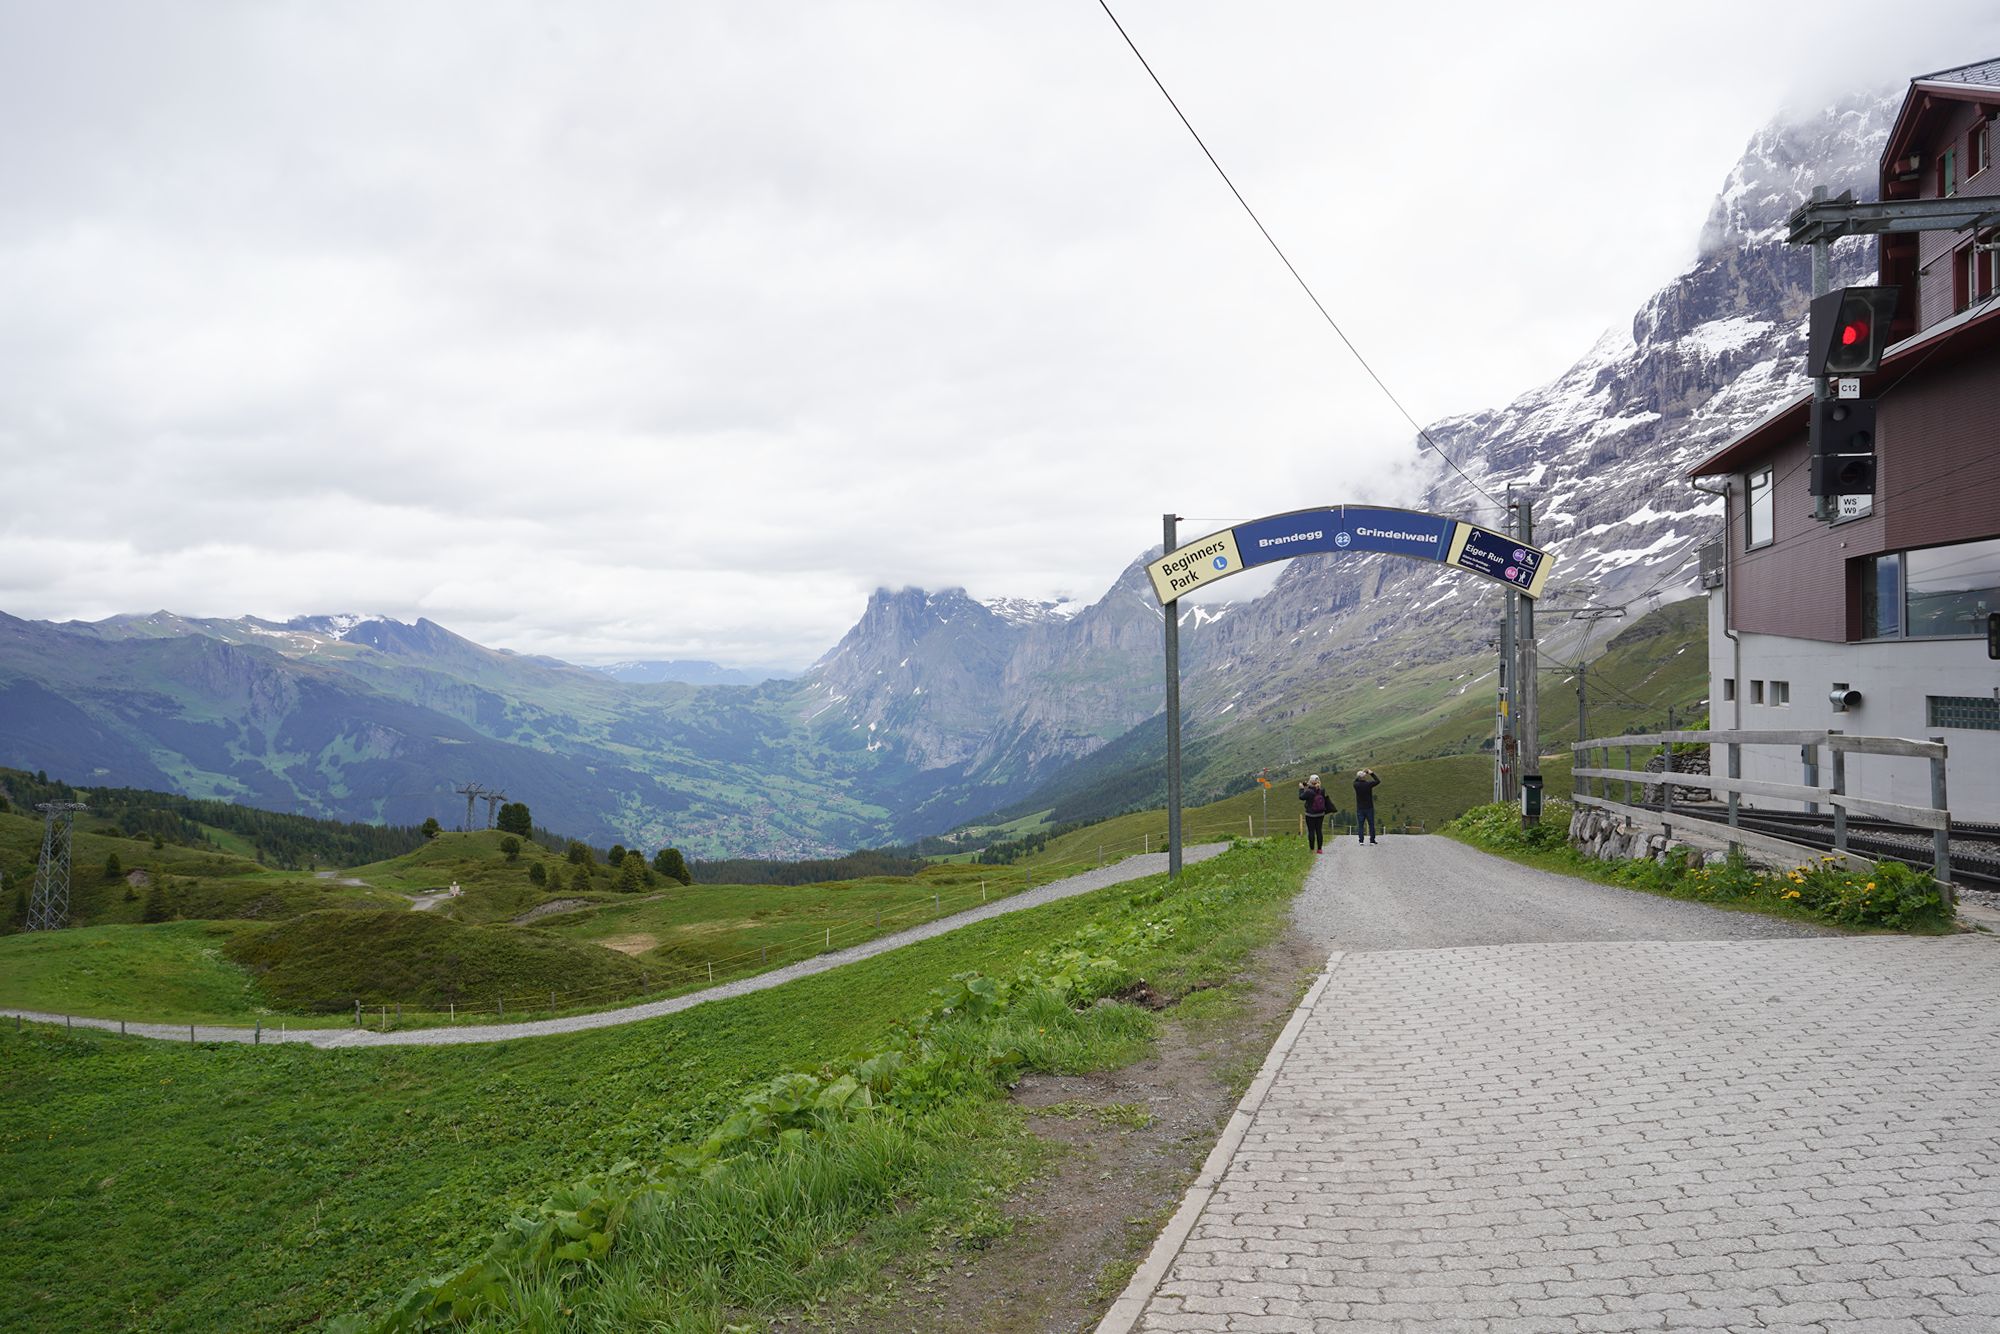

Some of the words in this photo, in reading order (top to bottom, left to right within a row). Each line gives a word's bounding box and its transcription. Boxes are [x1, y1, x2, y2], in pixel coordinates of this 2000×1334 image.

[1841, 384, 1857, 392] C12
[1259, 530, 1323, 547] Brandegg
[1337, 536, 1349, 544] 22
[1356, 527, 1438, 543] Grindelwald
[1162, 541, 1225, 576] Beginners
[1465, 544, 1487, 558] Eiger
[1488, 552, 1505, 564] Run
[1216, 559, 1225, 568] L
[1170, 570, 1199, 591] Park
